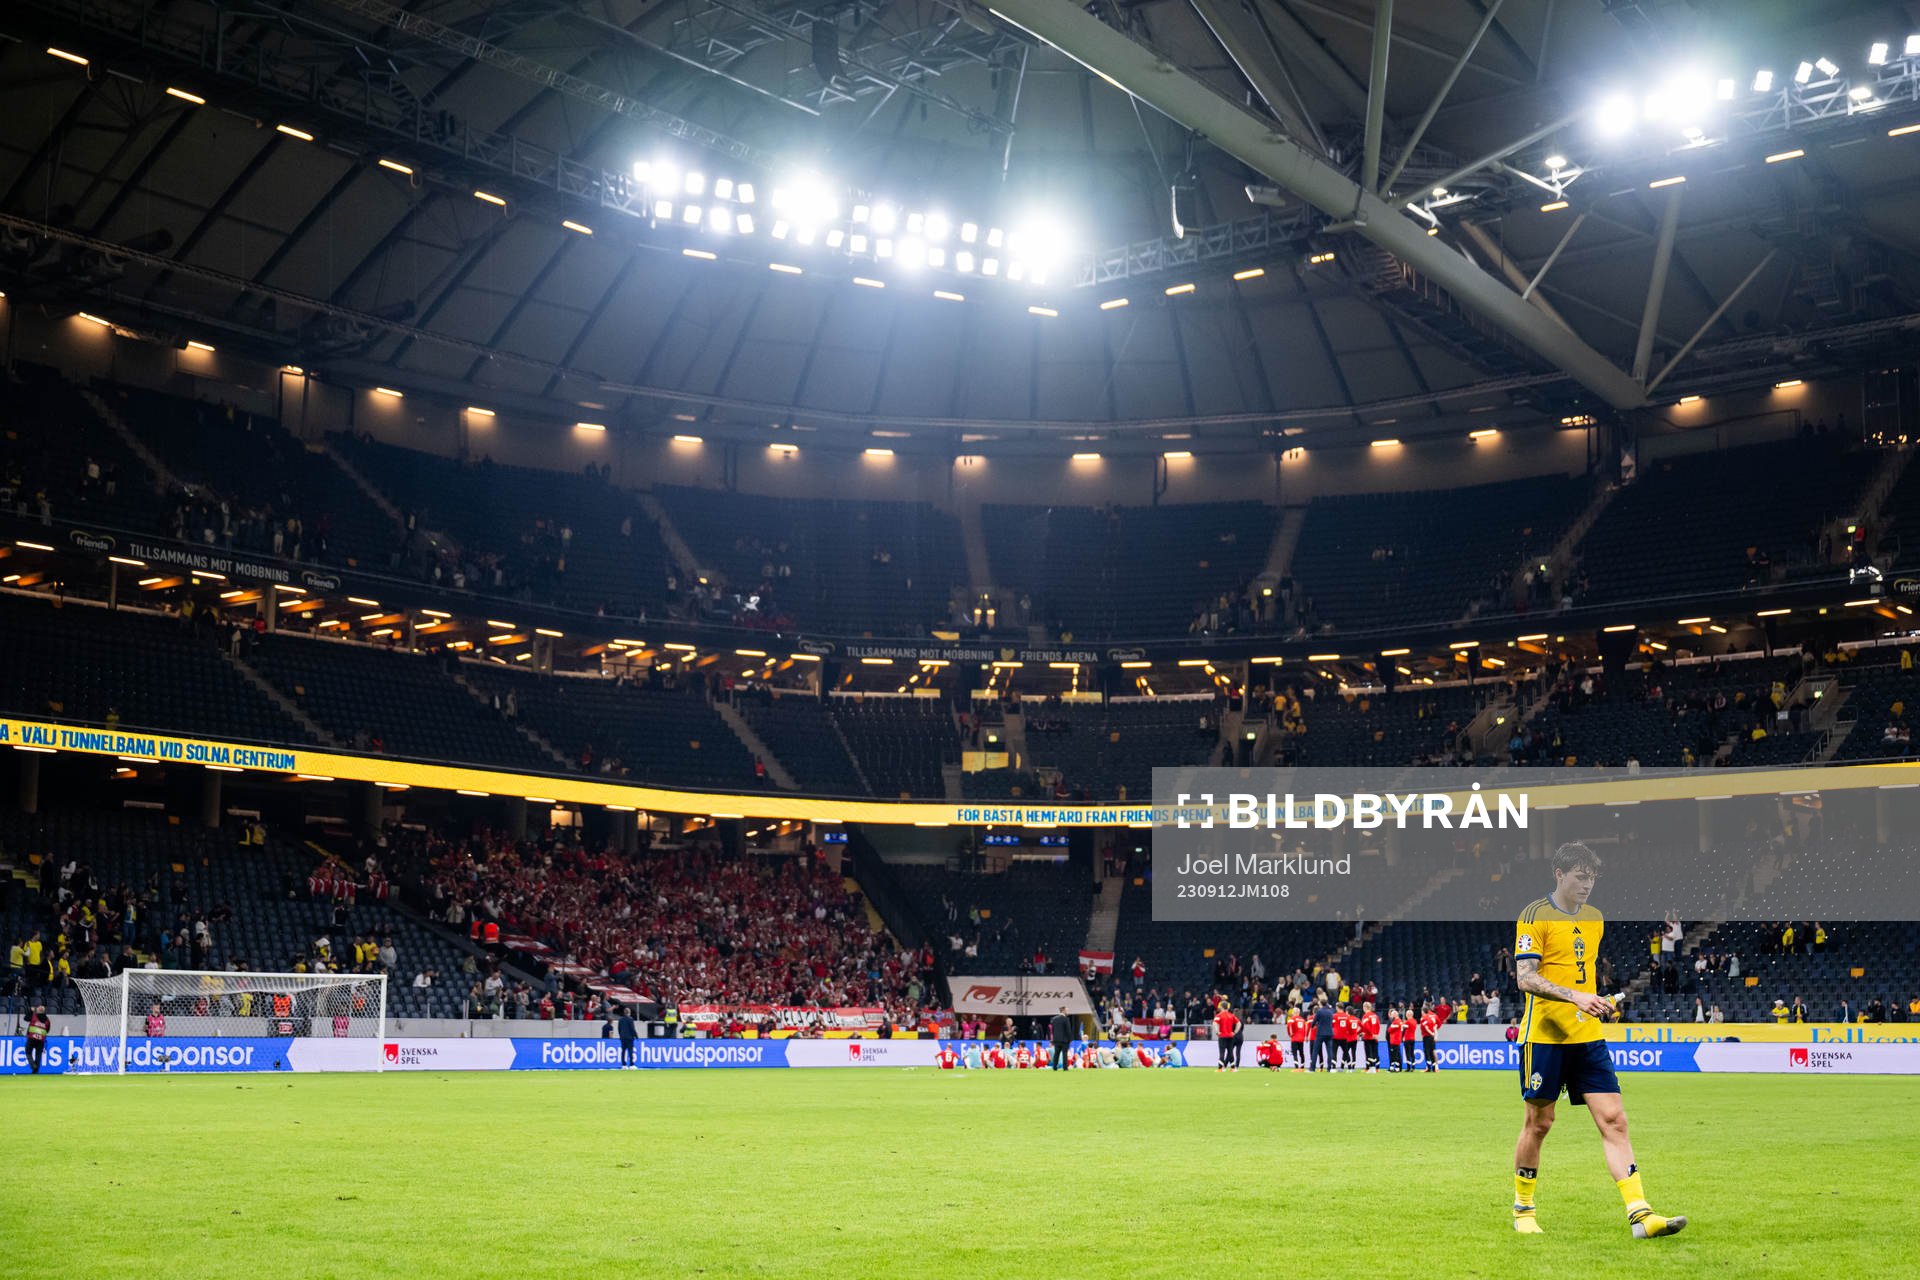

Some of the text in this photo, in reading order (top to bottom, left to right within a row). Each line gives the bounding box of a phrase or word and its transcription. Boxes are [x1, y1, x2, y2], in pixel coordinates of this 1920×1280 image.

[76, 535, 109, 551] friends
[129, 543, 290, 582] TILLSAMMANS MOT MOBBNING
[846, 646, 1099, 663] TILLSAMMANS MOT MOBBNING FRIENDS ARENA
[60, 730, 156, 757] TUNNELBANA
[160, 745, 182, 760] VID
[186, 747, 230, 764] SOLNA
[233, 750, 295, 770] CENTRUM
[1120, 808, 1168, 822] FRIENDS
[1575, 961, 1587, 985] 3
[1003, 990, 1074, 999] SVENSKA
[997, 998, 1033, 1006] SPEL
[401, 1048, 438, 1056] SVENSKA
[641, 1041, 763, 1068] huvudsponsor
[1811, 1052, 1852, 1060] SVENSKA
[401, 1057, 421, 1065] SPEL
[1811, 1060, 1833, 1068] SPEL
